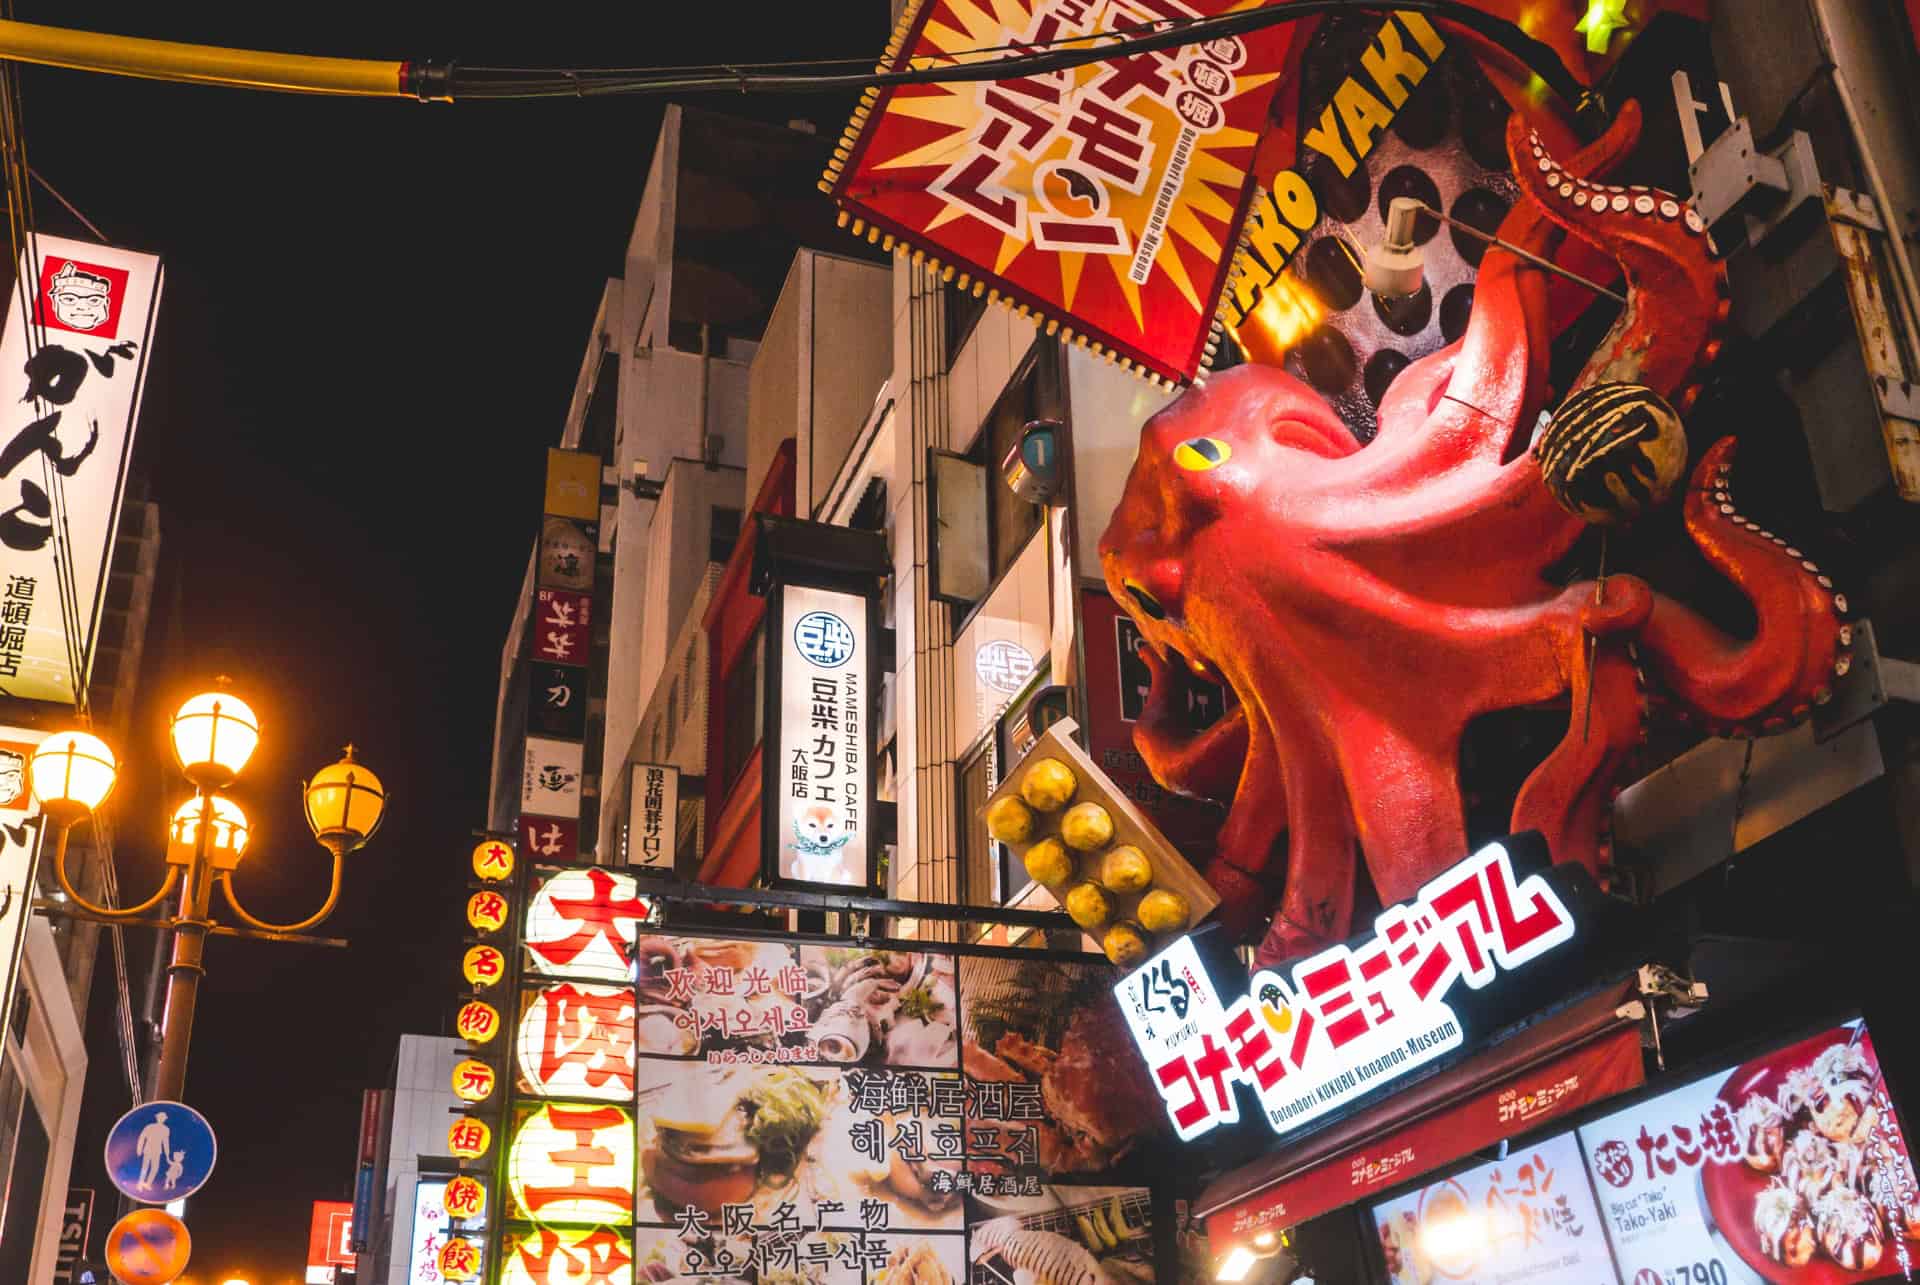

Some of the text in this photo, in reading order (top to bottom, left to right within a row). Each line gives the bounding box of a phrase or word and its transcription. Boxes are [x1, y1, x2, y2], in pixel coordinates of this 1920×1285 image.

[1224, 10, 1446, 327] AKO YAKI
[811, 677, 838, 802] 豆柴カフェ
[844, 673, 858, 831] MAMESHIBA CAFE
[791, 748, 808, 799] 大阪店
[665, 965, 809, 1000] 欢迎光临
[1142, 959, 1189, 1020] くくる
[1157, 860, 1563, 1130] コナモンミュージアム
[673, 1005, 813, 1040] 어서오세요
[708, 1046, 817, 1065] いらっしゃいませ
[1316, 1071, 1357, 1102] KUKURU
[1355, 1020, 1457, 1082] Konamon-Museum
[849, 1075, 1045, 1122] 海鲜居酒屋
[1636, 1104, 1741, 1180] たこ焼
[675, 1199, 890, 1239] 大阪名产物
[1615, 1201, 1677, 1232] Tako-Yaki
